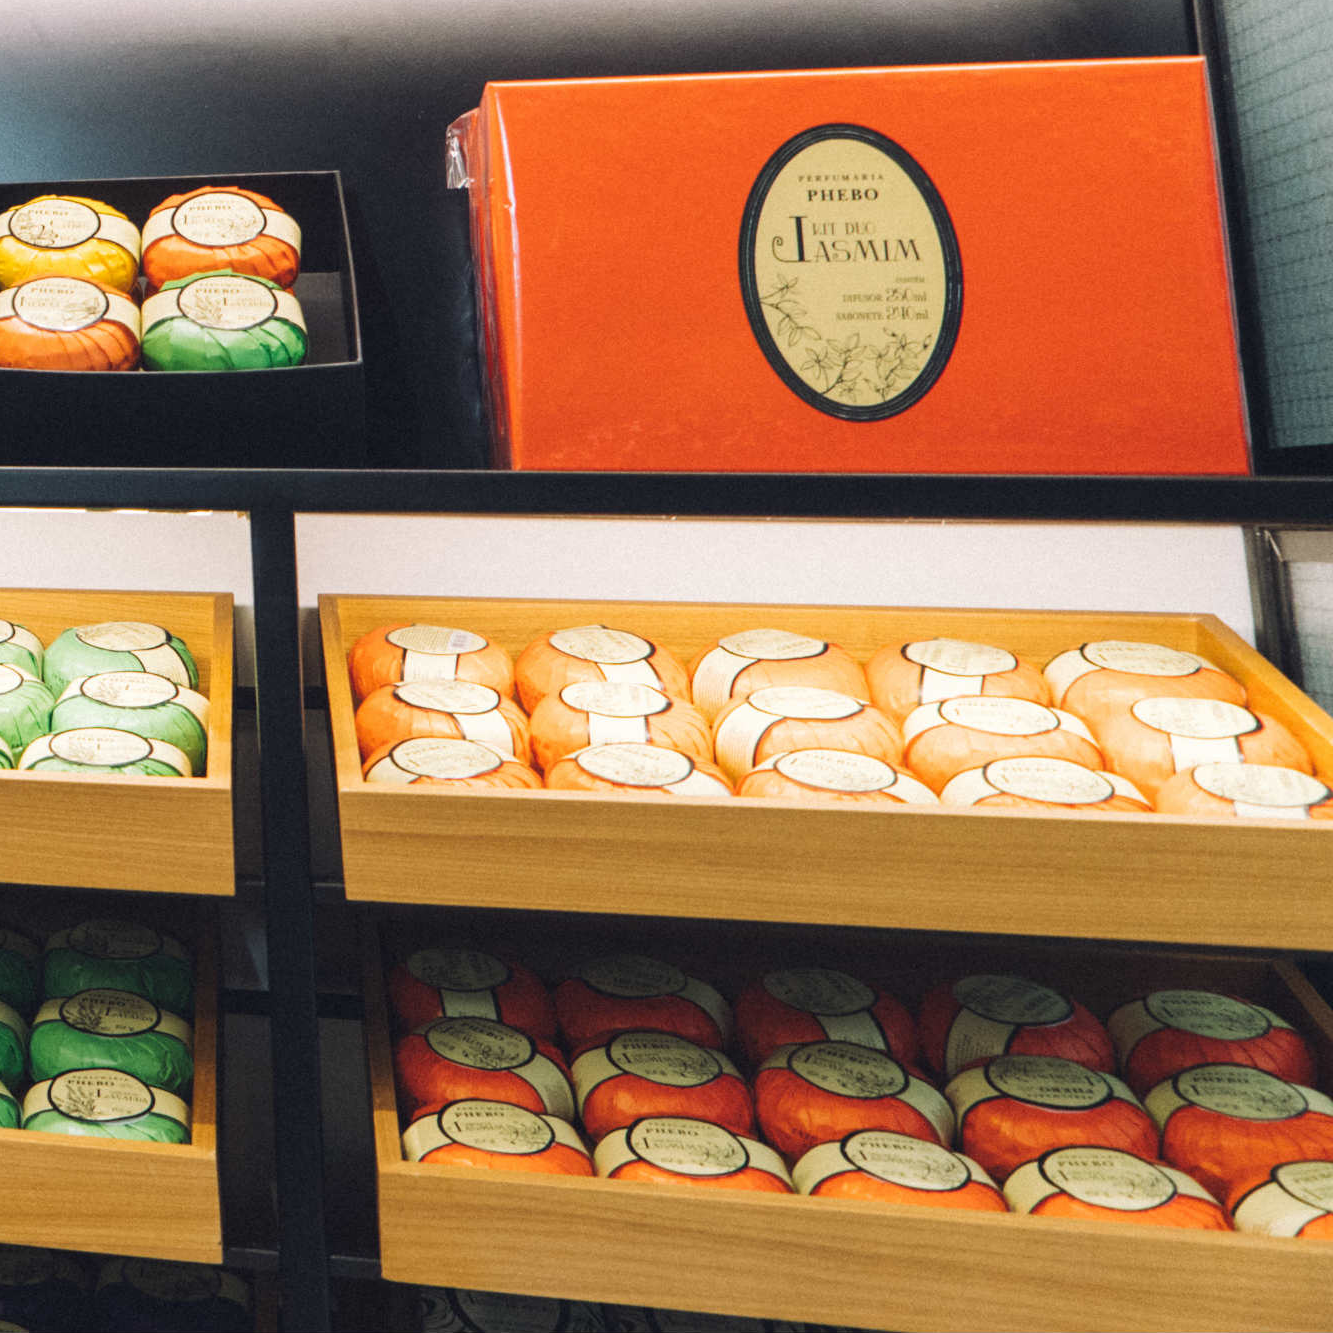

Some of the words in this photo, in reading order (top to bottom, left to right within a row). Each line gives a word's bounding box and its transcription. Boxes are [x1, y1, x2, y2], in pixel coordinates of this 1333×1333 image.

[797, 173, 885, 184] PERFUMARIA
[806, 188, 879, 203] PHEBO
[771, 215, 922, 264] JASMIM
[835, 309, 884, 321] SABONETE
[66, 1079, 116, 1088] PHEBO
[454, 1109, 506, 1119] PHEBO
[644, 1127, 700, 1138] PHEBO
